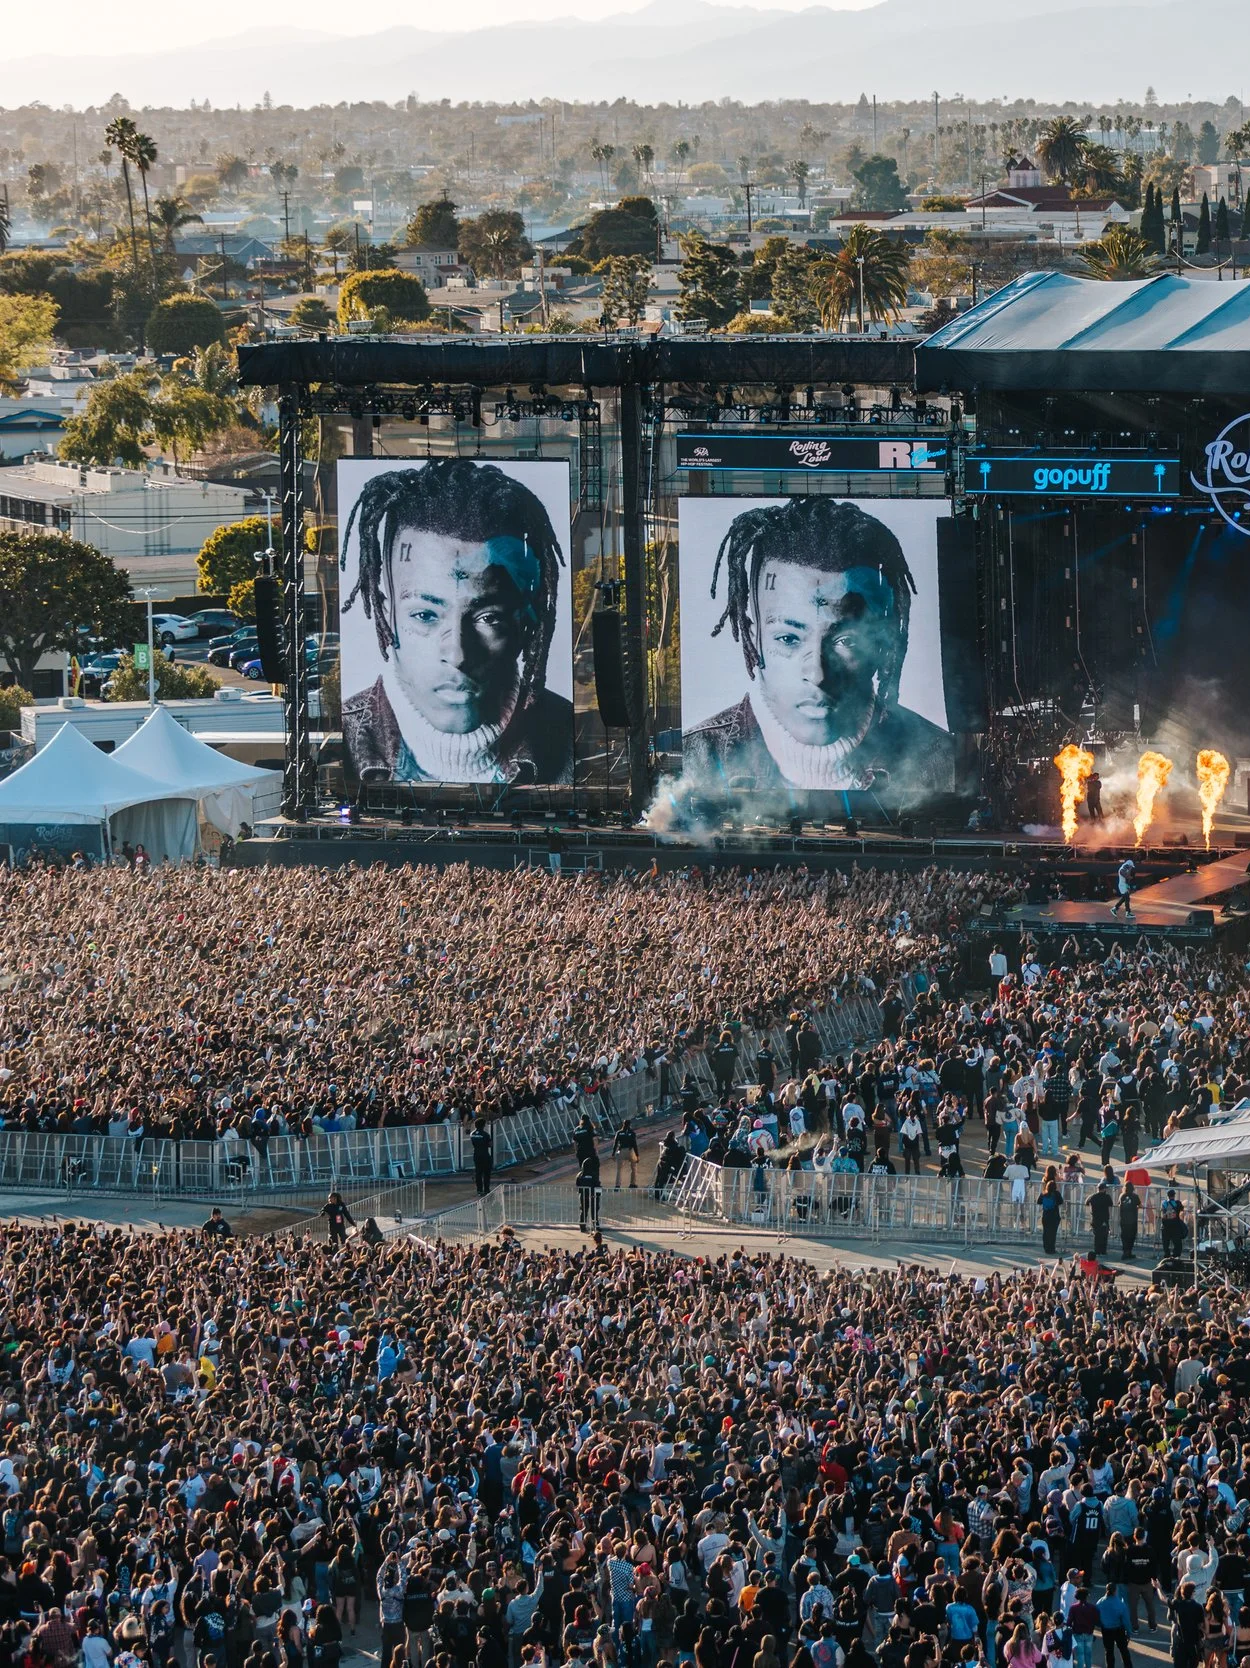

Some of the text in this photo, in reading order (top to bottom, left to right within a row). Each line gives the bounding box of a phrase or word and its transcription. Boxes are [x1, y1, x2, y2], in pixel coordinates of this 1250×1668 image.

[789, 441, 830, 455] Rolling
[879, 442, 936, 468] RL
[798, 452, 831, 467] Loud
[1034, 463, 1111, 491] gopuff
[139, 652, 147, 663] B
[1086, 1517, 1098, 1528] 10
